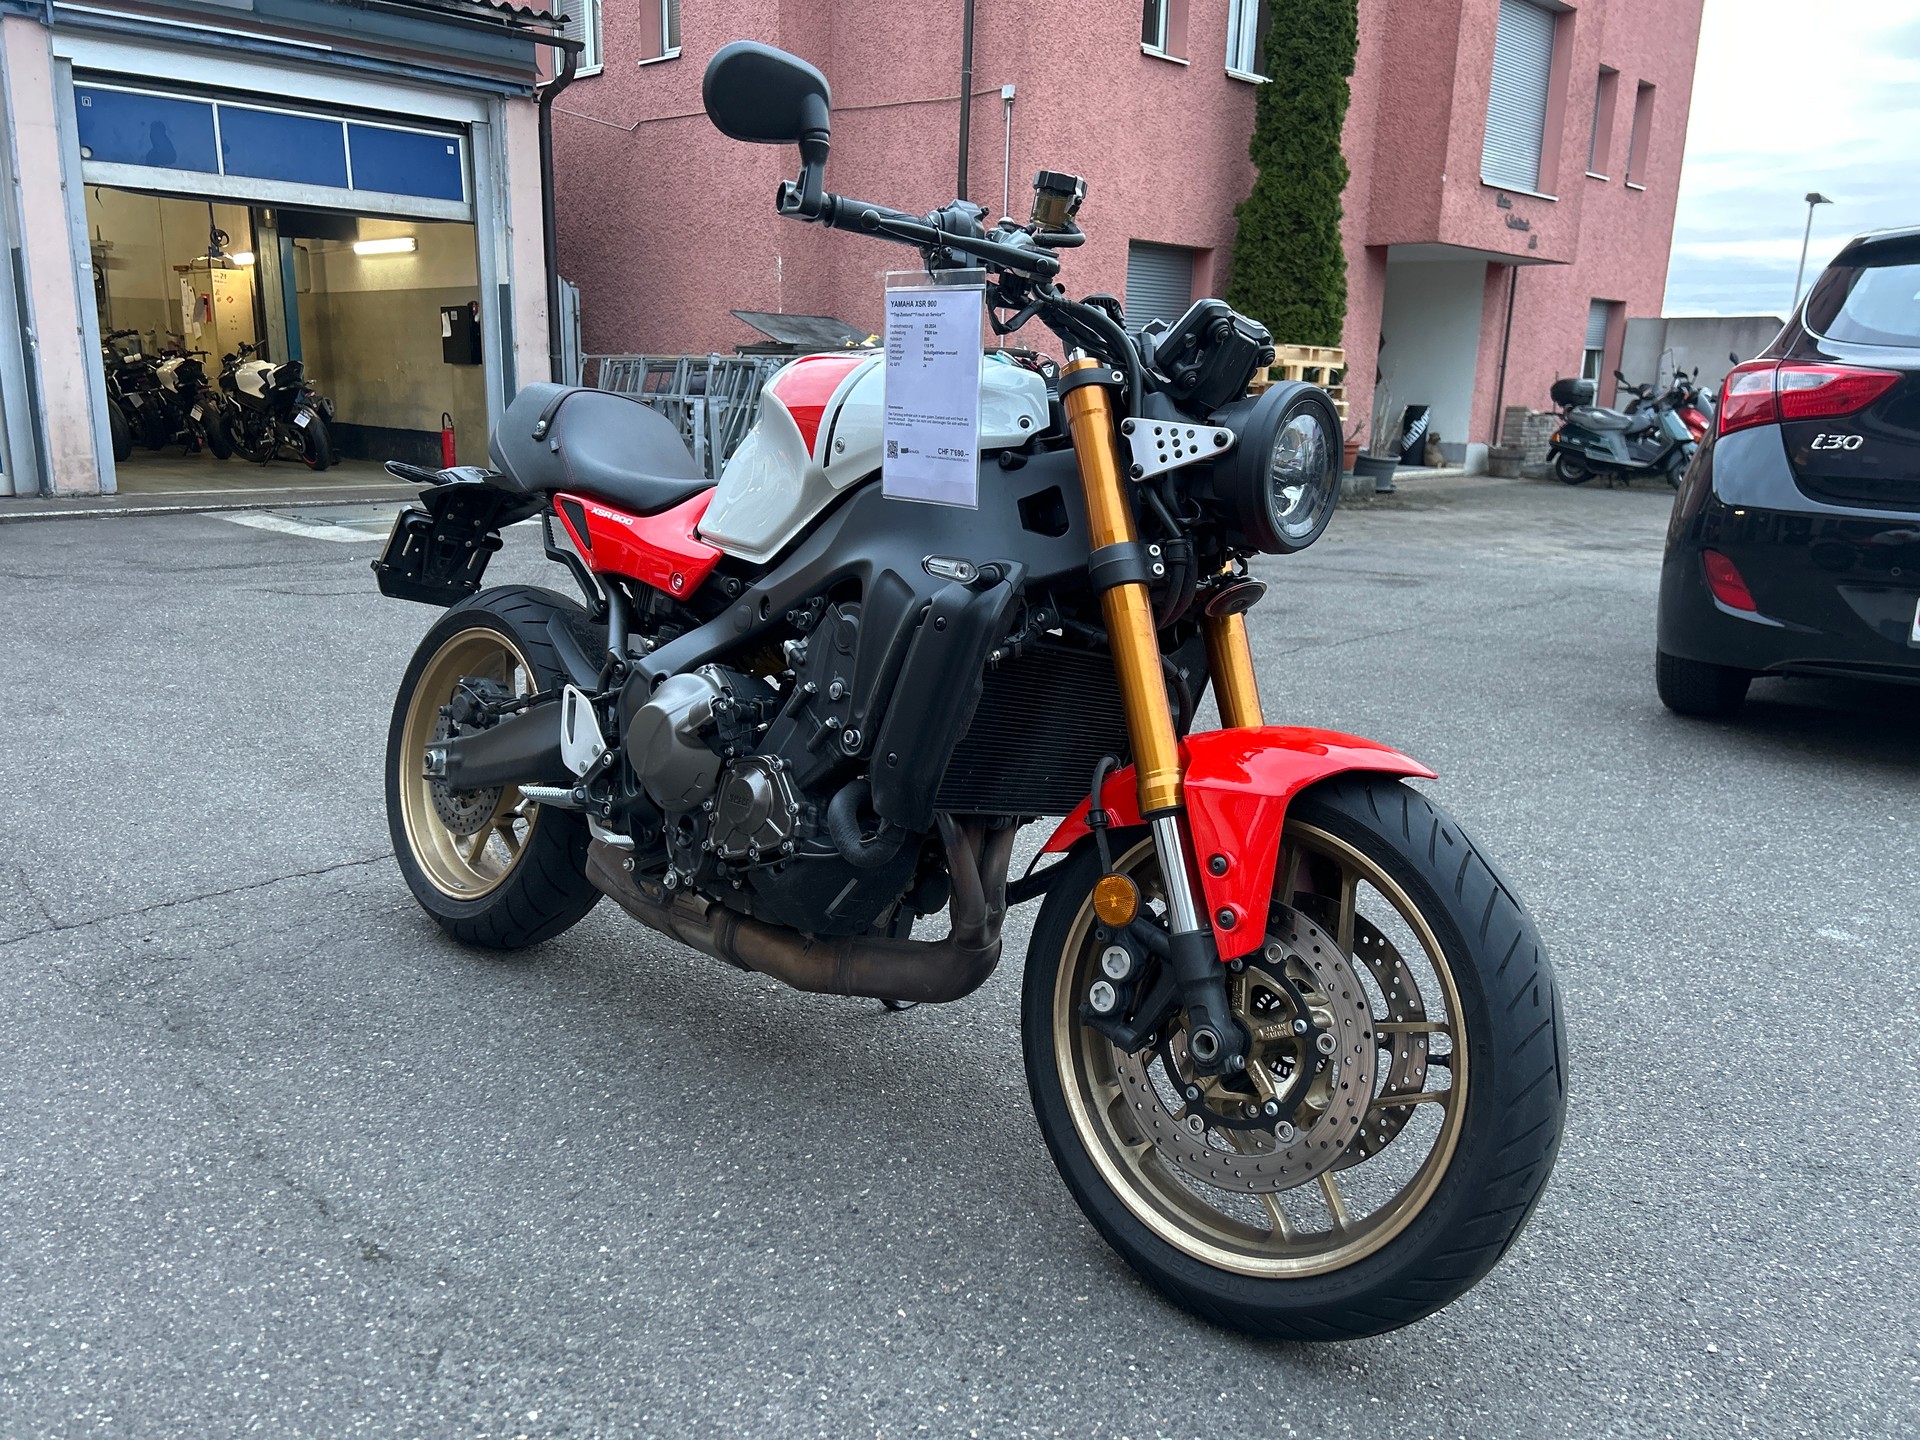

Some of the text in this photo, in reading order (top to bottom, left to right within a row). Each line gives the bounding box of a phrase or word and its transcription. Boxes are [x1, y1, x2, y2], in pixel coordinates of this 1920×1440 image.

[891, 300, 937, 308] YAMAHA XSR 900
[1811, 433, 1864, 451] i30
[937, 447, 949, 456] CHF
[591, 507, 633, 525] XSR 900
